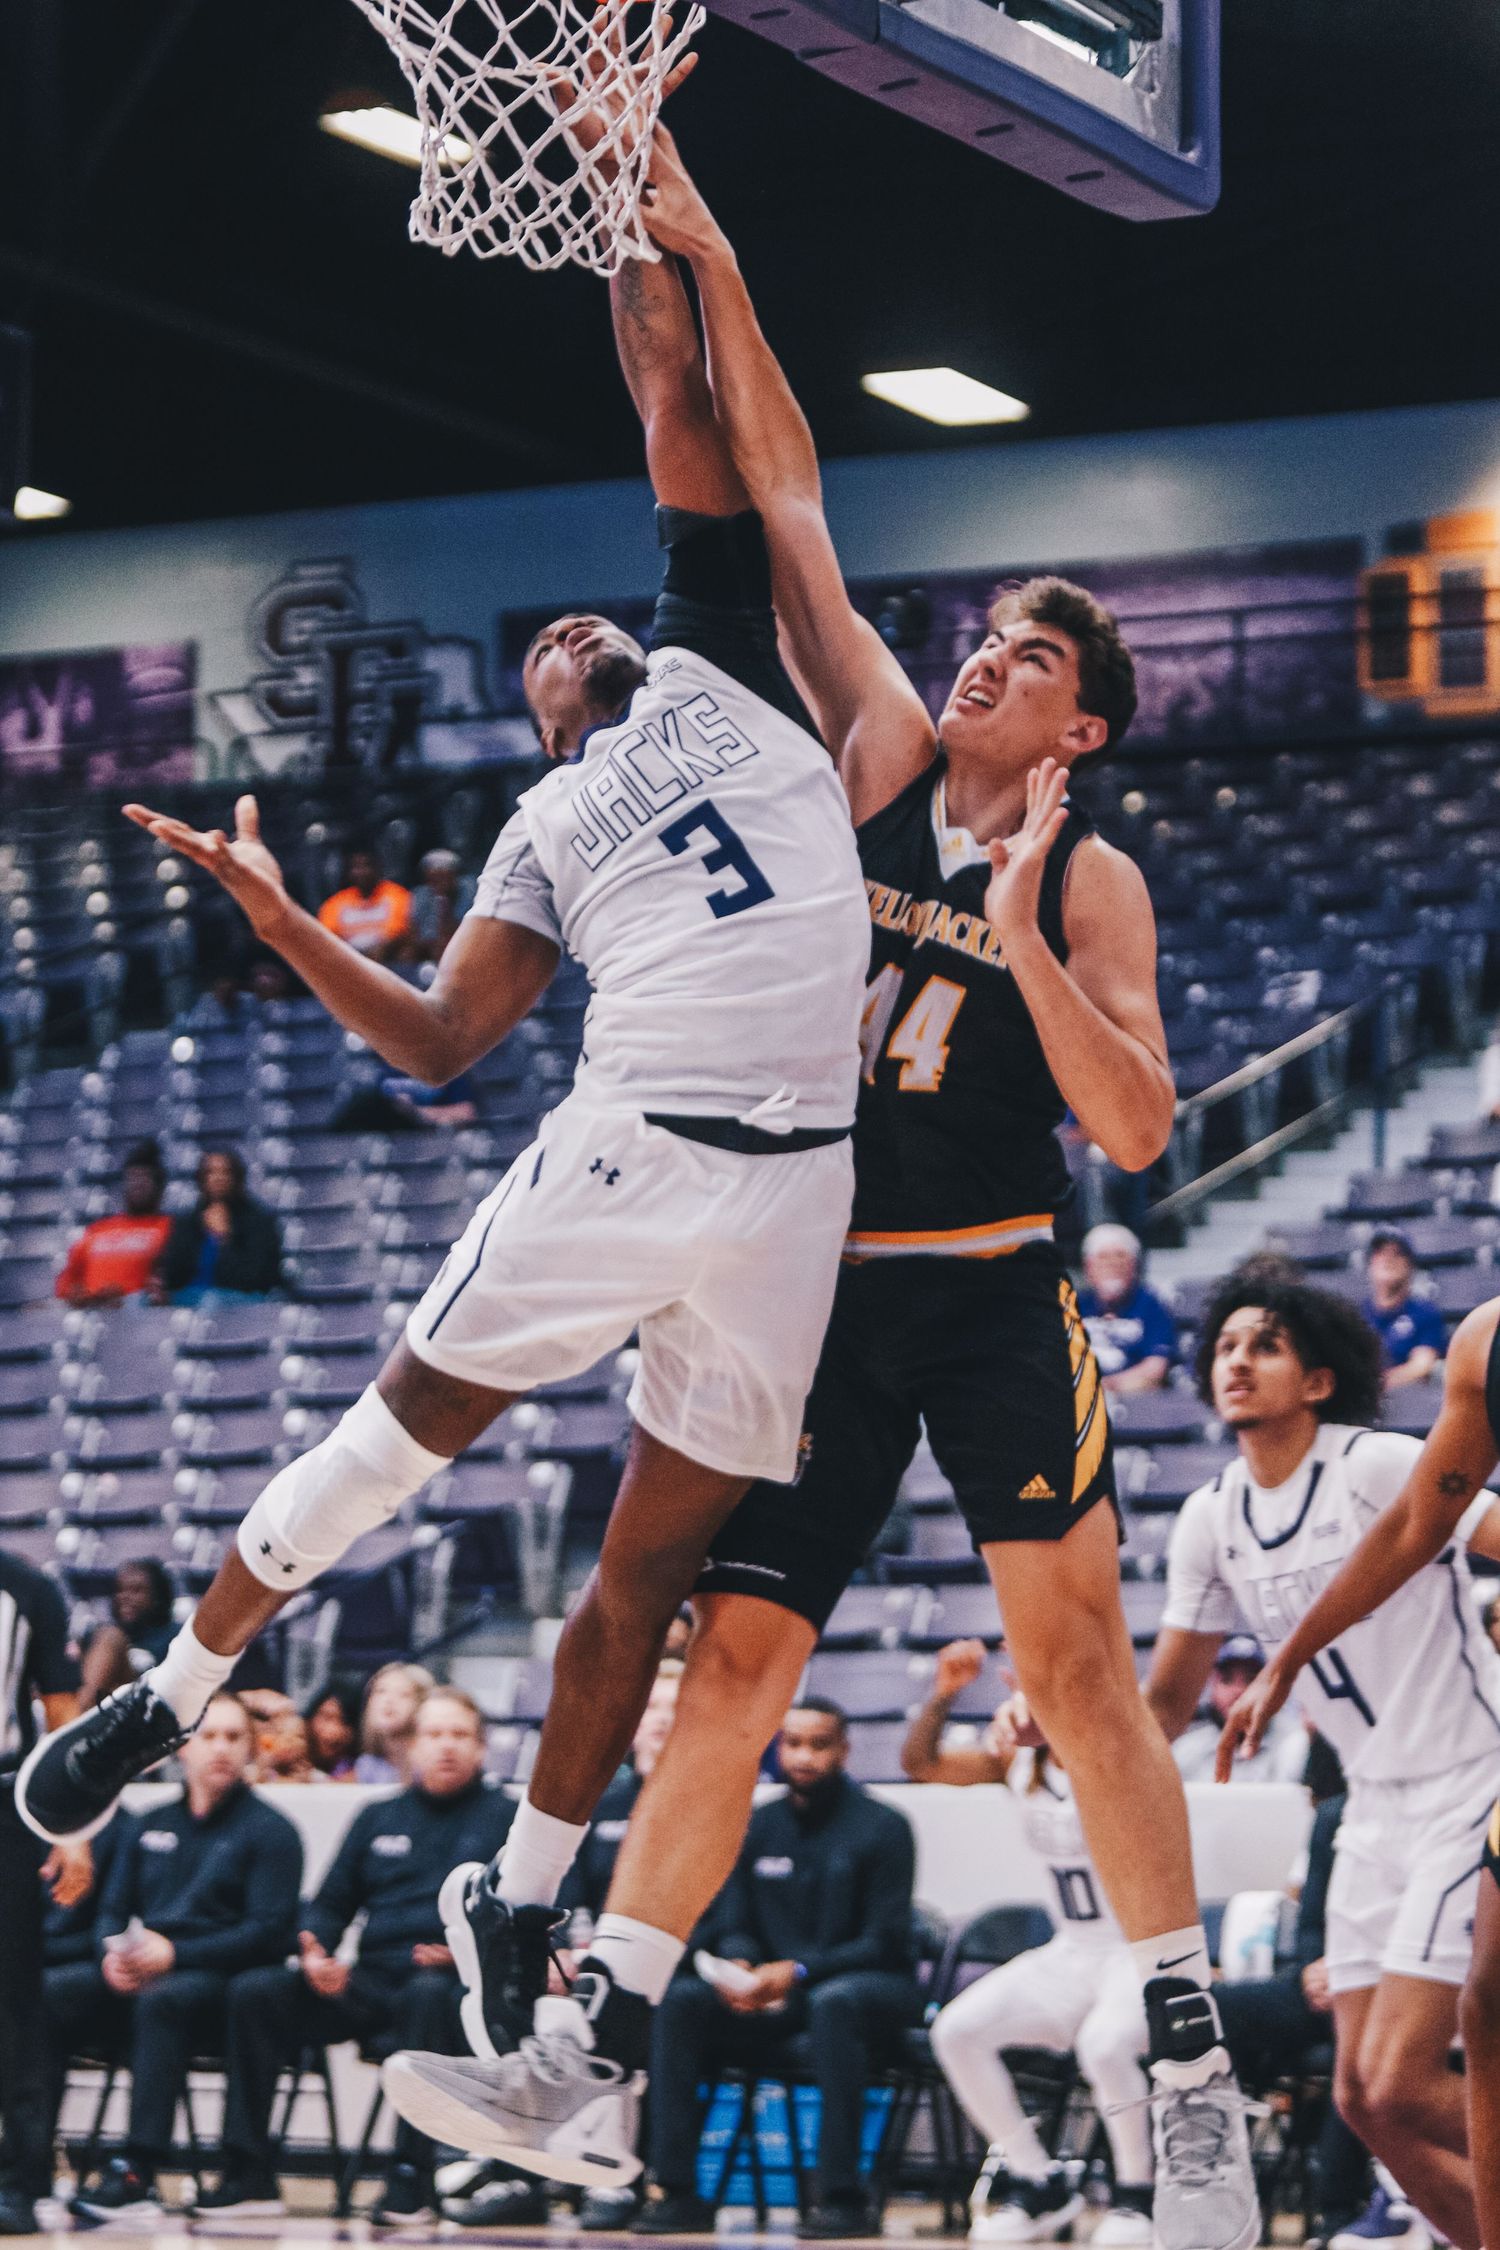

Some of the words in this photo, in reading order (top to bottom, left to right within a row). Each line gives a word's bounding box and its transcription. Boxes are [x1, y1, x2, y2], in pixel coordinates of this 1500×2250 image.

[570, 691, 760, 873] JACKS
[657, 797, 776, 919] 3
[858, 961, 967, 1092] 44
[1309, 1648, 1376, 1727] 4
[1049, 1865, 1101, 1921] 10
